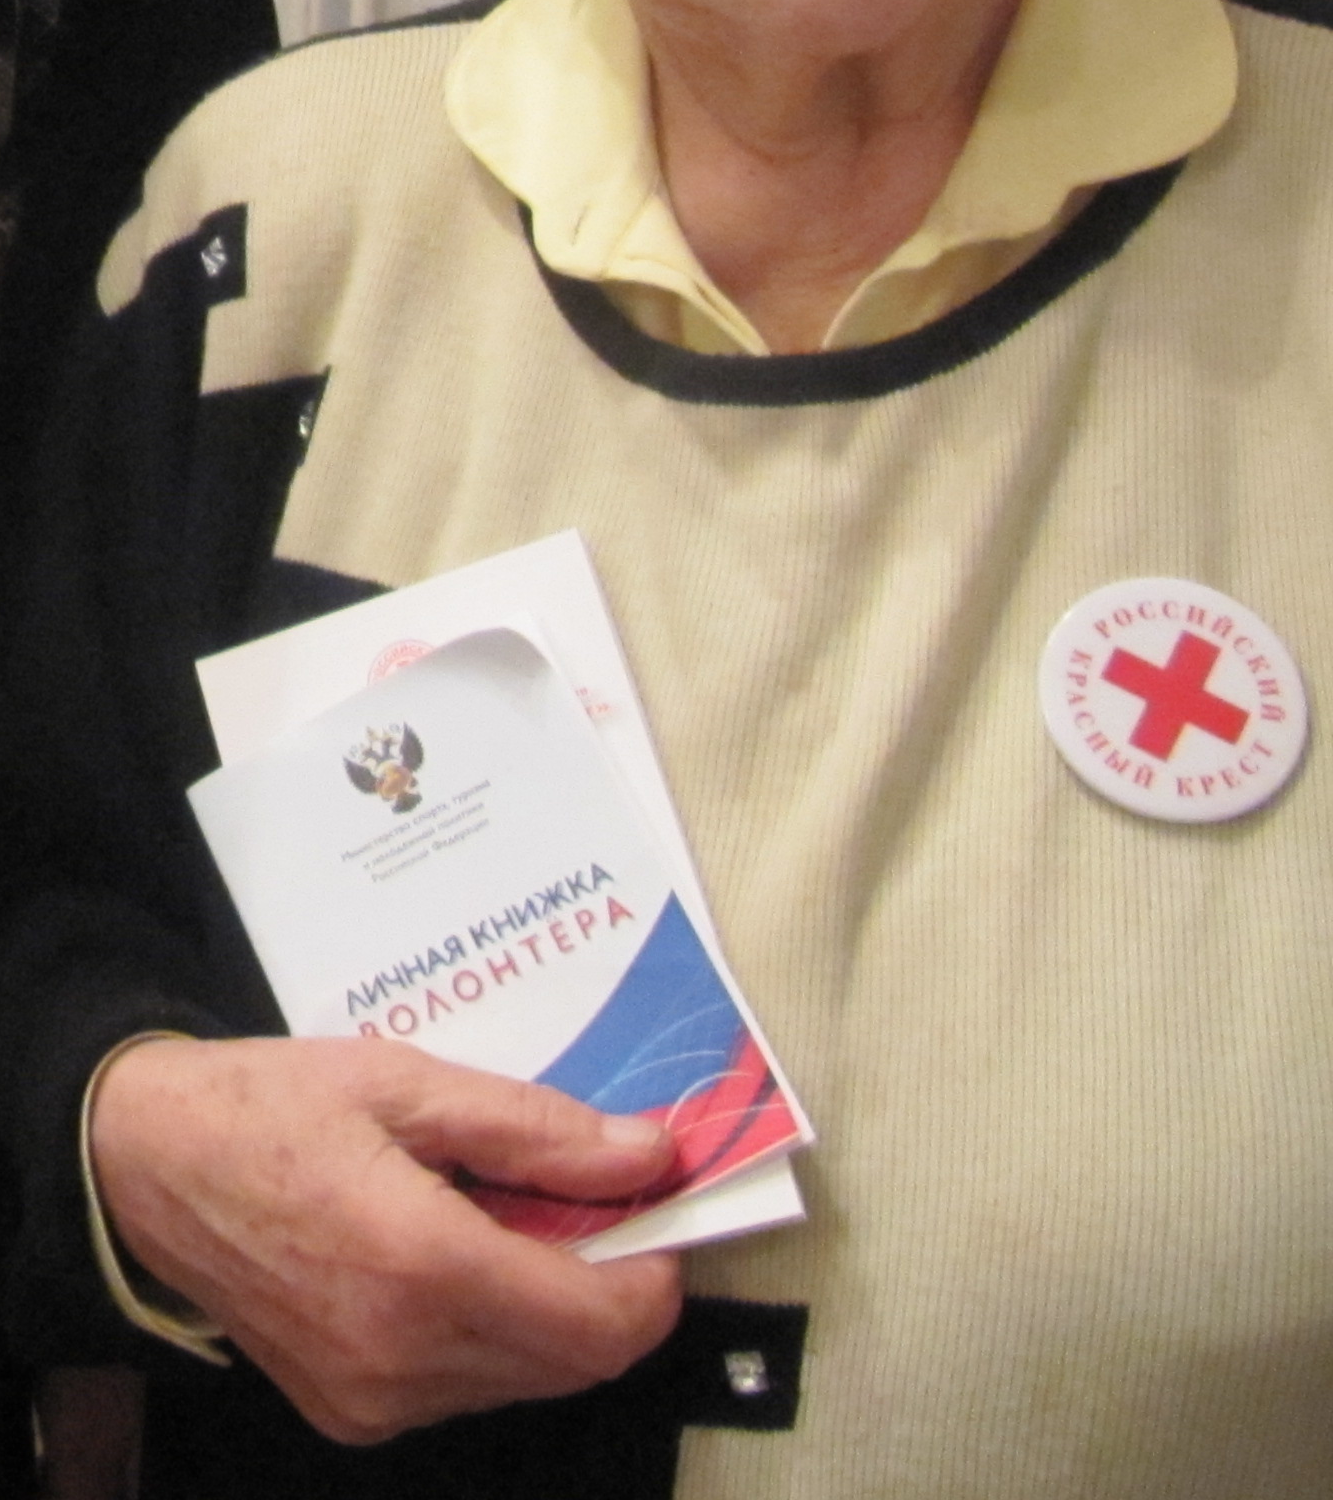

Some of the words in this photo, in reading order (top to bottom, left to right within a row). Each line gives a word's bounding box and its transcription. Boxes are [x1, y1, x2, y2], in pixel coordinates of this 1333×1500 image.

[1067, 649, 1155, 790] КРАСНЫЙ
[1176, 739, 1273, 797] КРЕСТ
[1093, 600, 1286, 724] РОССИЙСКИЙ
[345, 933, 468, 1017] ЛИЧНАЯ
[468, 862, 616, 951] КНИЖКА
